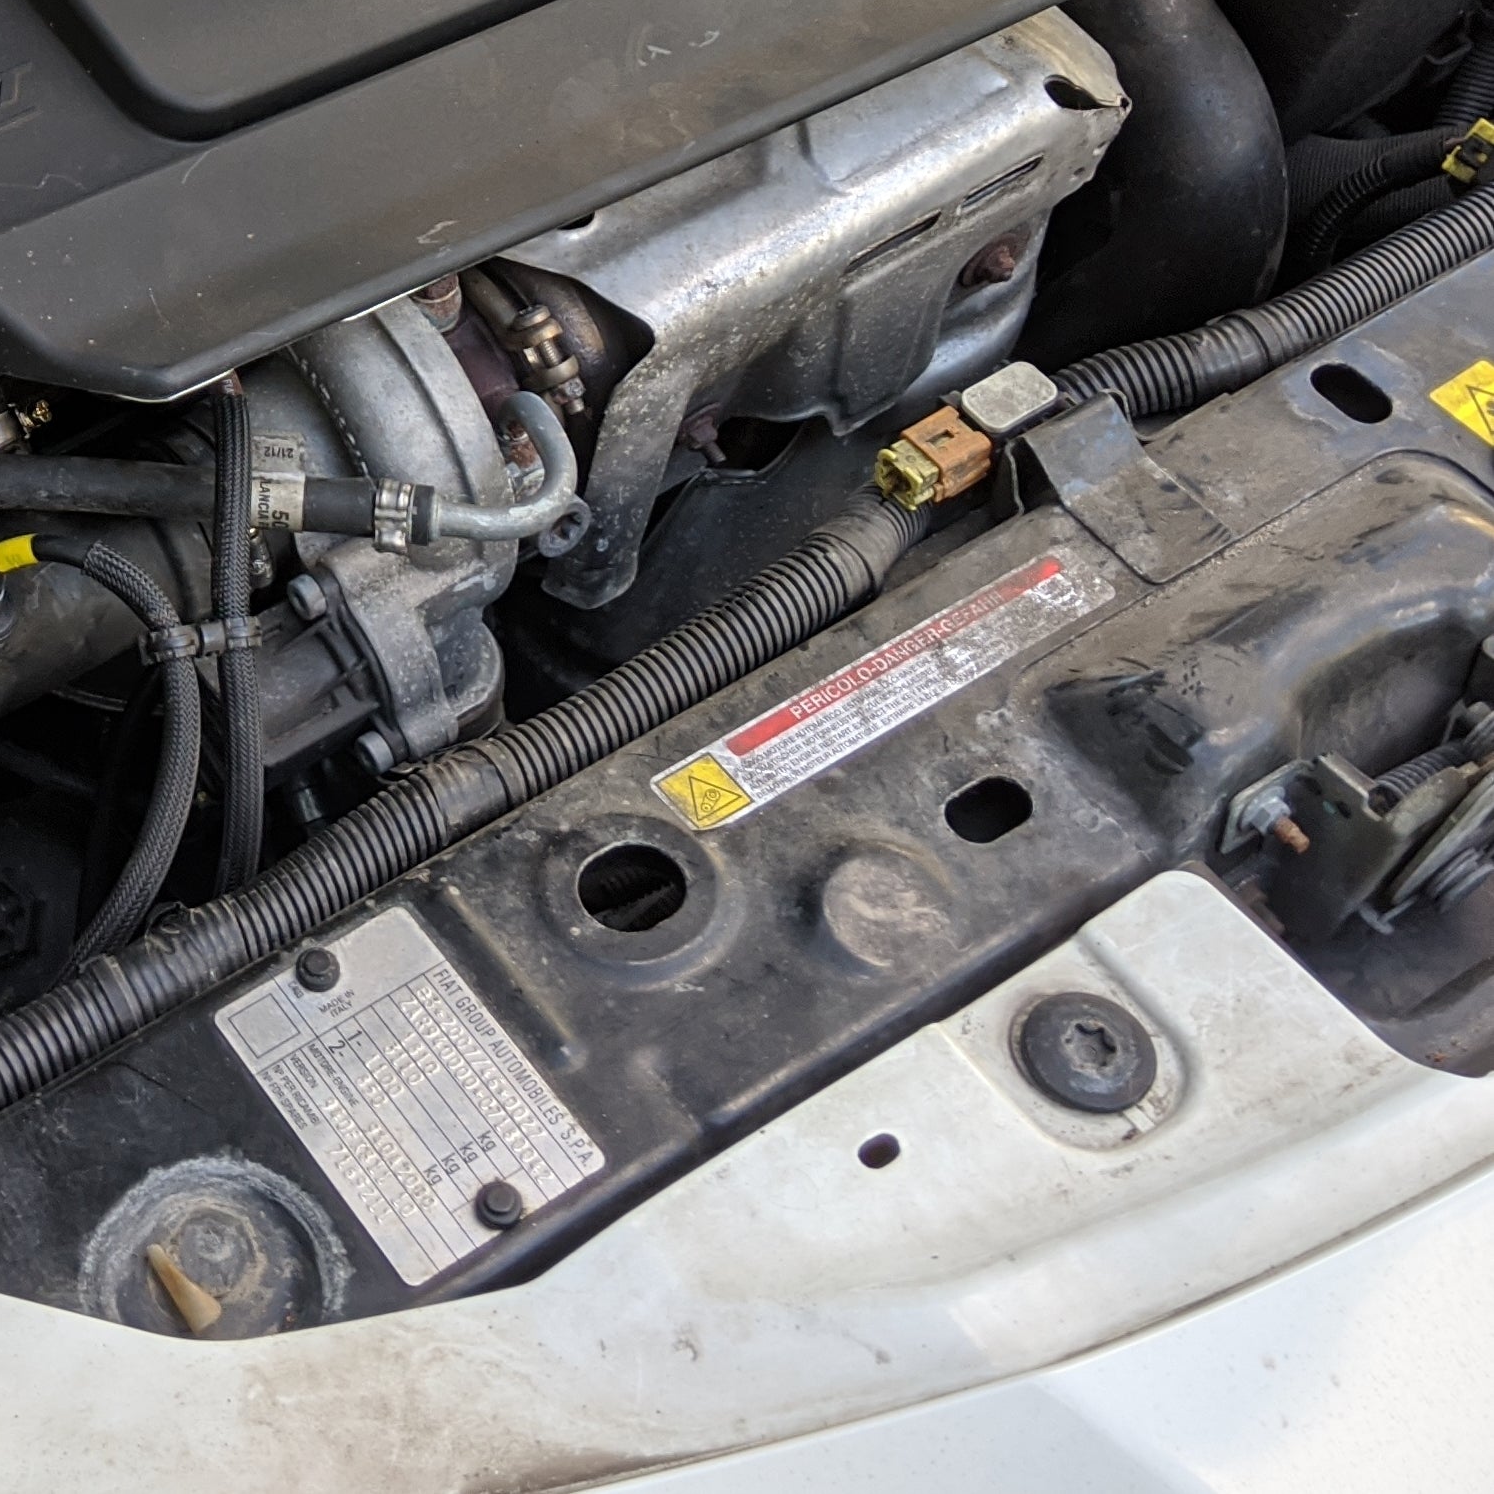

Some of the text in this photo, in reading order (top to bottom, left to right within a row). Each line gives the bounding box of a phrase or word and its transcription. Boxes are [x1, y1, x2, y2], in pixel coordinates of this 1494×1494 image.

[264, 446, 293, 458] 21/12
[318, 997, 343, 1012] MADE
[330, 1000, 352, 1017] ITALY
[290, 1053, 317, 1088] VERSION
[433, 969, 592, 1166] FIAT GROUP AUTOMOBILES S.P.A.
[456, 1141, 477, 1165] kg
[474, 1130, 496, 1153] kg
[421, 1164, 442, 1185] kg
[438, 1152, 460, 1176] kg
